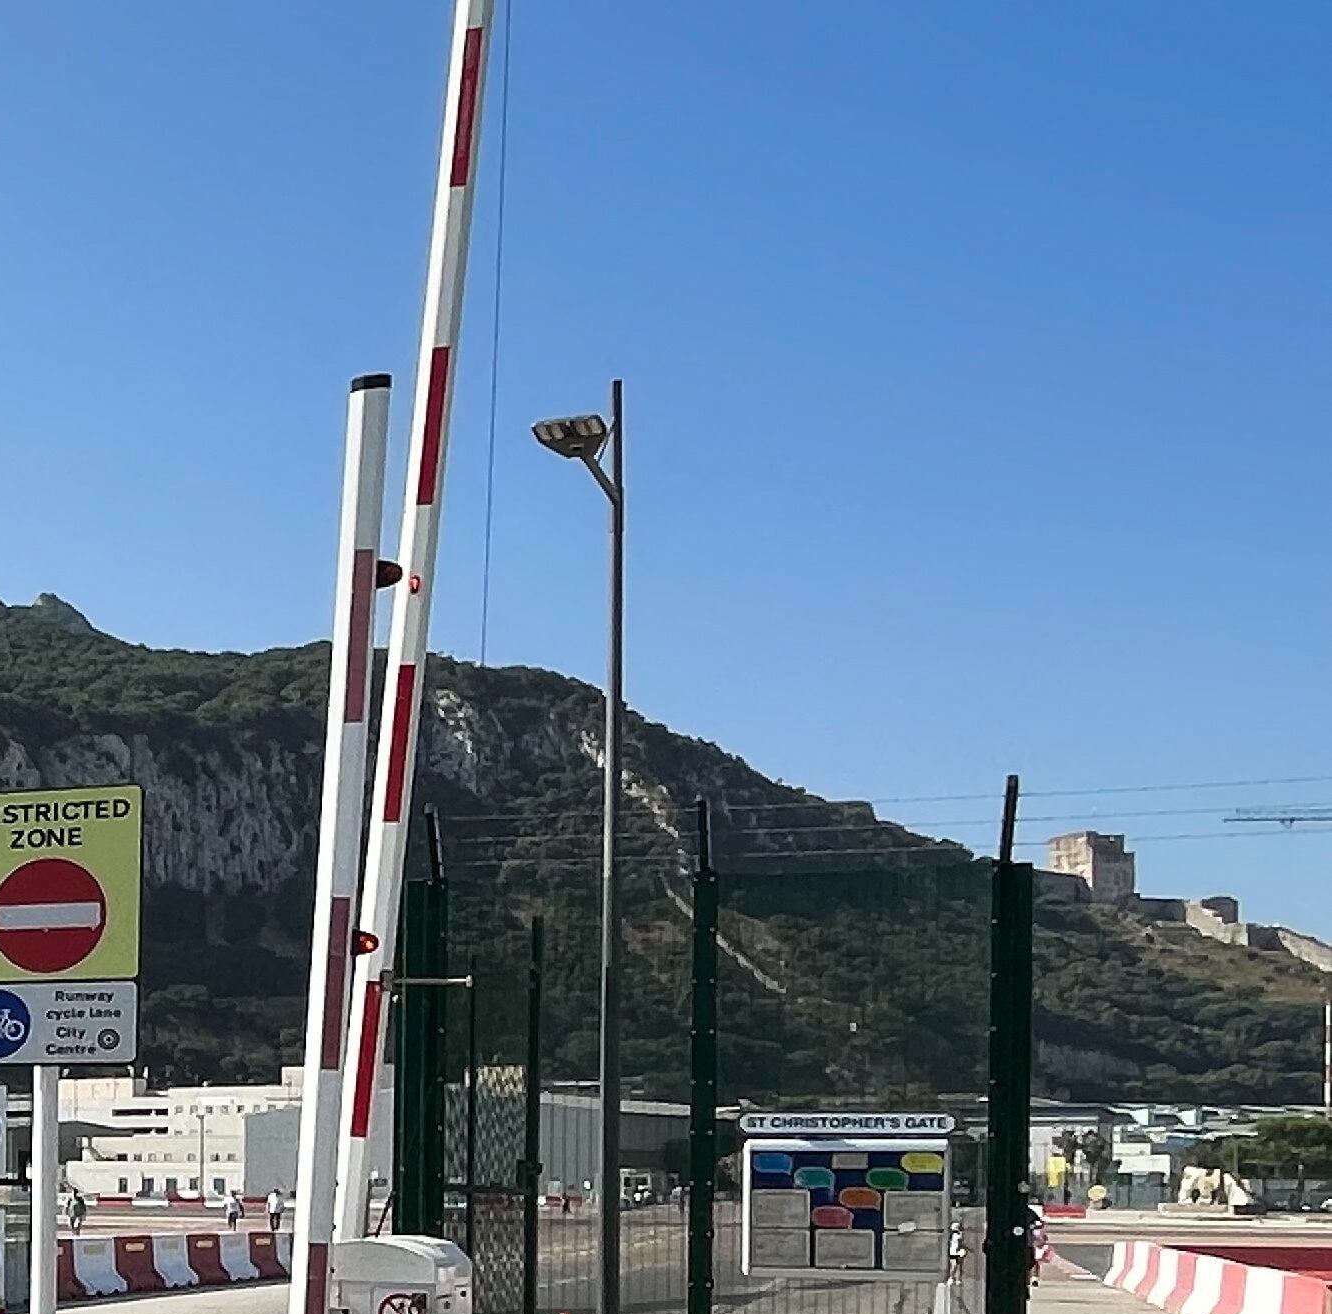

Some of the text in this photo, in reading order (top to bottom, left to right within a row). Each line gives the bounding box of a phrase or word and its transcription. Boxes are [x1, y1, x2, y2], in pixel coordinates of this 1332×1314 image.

[10, 827, 83, 849] ZONE
[55, 990, 115, 1003] Runway
[45, 1007, 85, 1021] cycle
[56, 1026, 87, 1040] City
[45, 1043, 97, 1055] Centre
[747, 1116, 767, 1128] ST
[904, 1116, 947, 1129] GATE
